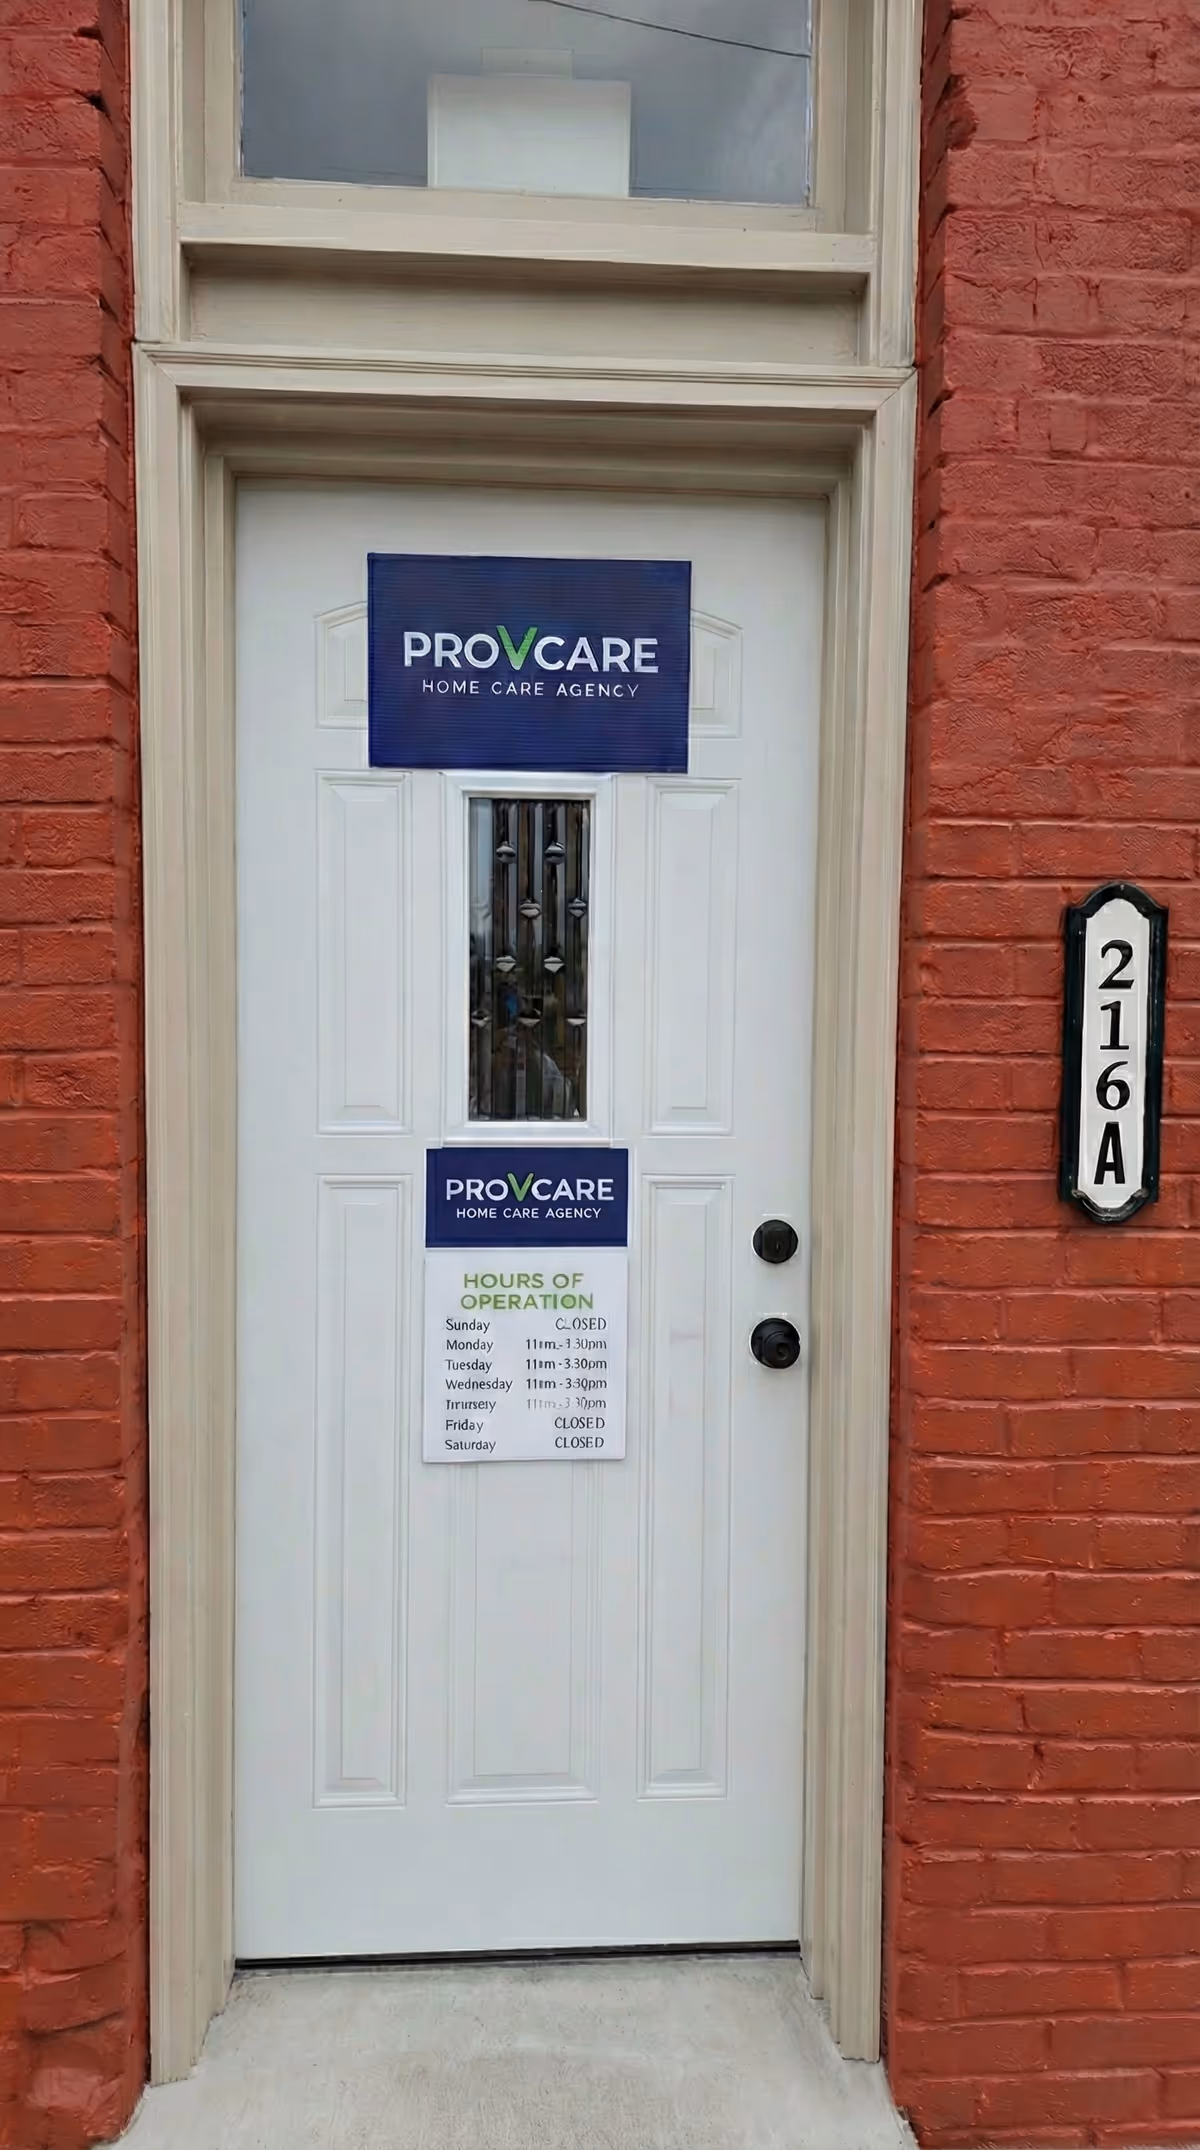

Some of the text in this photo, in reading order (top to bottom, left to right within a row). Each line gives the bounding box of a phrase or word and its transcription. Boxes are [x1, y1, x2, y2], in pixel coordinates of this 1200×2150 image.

[403, 625, 659, 673] PROVCARE
[422, 679, 640, 698] HOME CARE AGENCY
[1093, 939, 1135, 1185] 216A
[446, 1173, 614, 1202] PROVCARE
[456, 1208, 601, 1218] HOME CARE AGENCY
[464, 1273, 584, 1289] HOURS OF
[461, 1293, 593, 1310] OPERATION
[446, 1317, 607, 1334] Sunday CLOSED
[446, 1338, 494, 1353] Monday
[445, 1358, 492, 1374] Tuesday
[445, 1377, 513, 1393] Wednesday
[445, 1416, 605, 1434] Friday CLOSED
[445, 1436, 605, 1454] Saturday CLOSED
